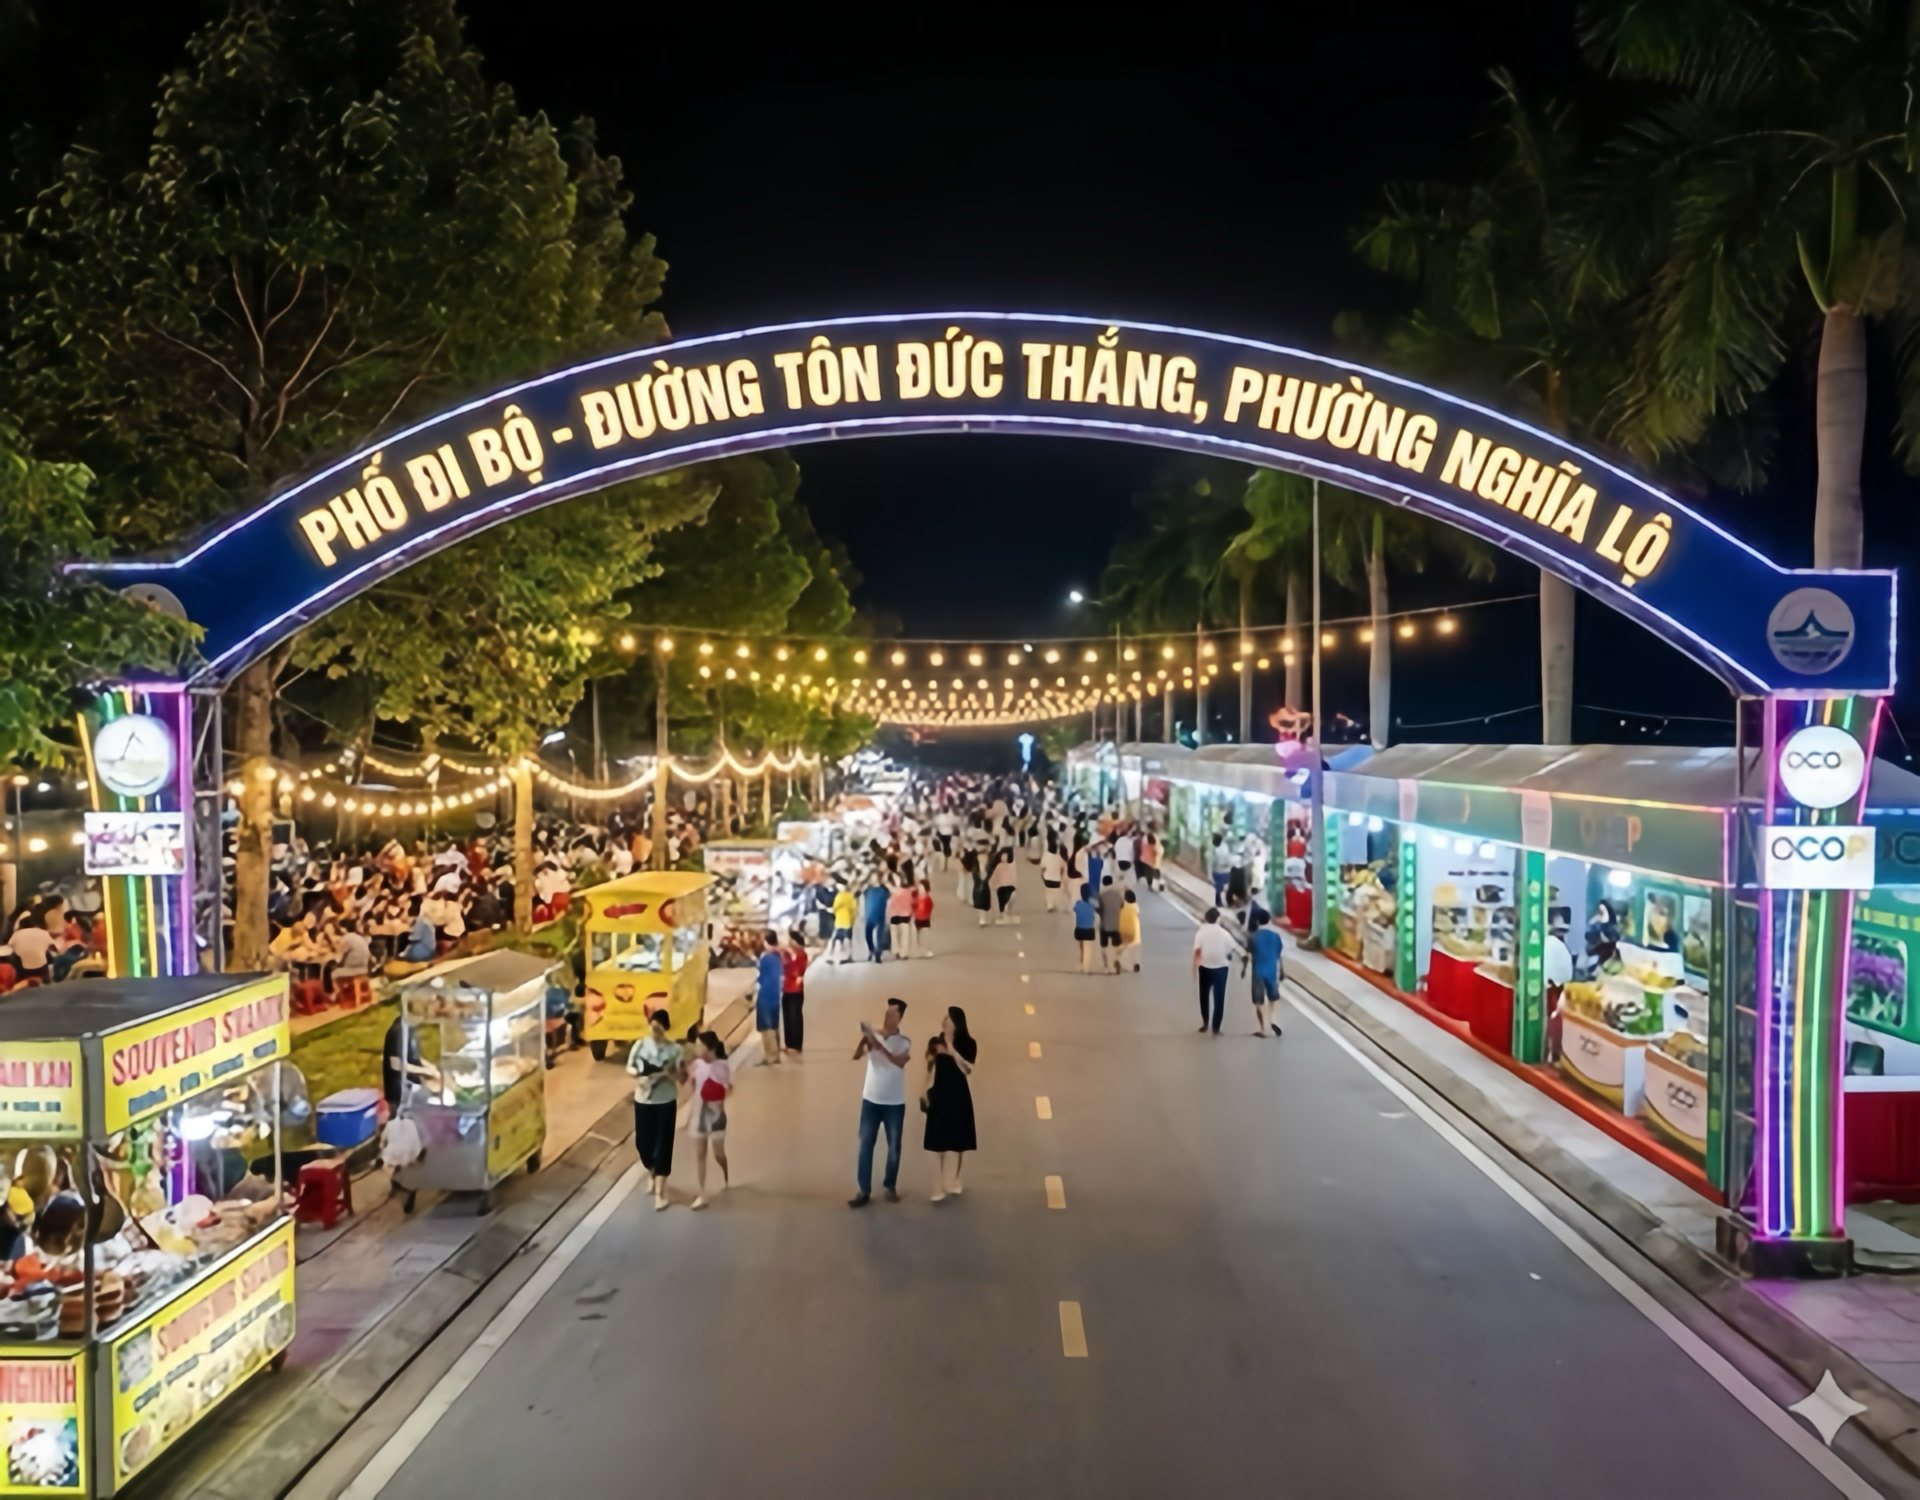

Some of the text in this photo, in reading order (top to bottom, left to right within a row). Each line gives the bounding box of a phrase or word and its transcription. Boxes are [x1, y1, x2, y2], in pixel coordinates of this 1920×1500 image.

[300, 326, 1673, 588] PHỐ ĐI BỘ - ĐƯỜNG TÔN ĐỨC THẮNG, PHƯỜNG NGHĨA LỘ
[1771, 835, 1867, 861] OCOP
